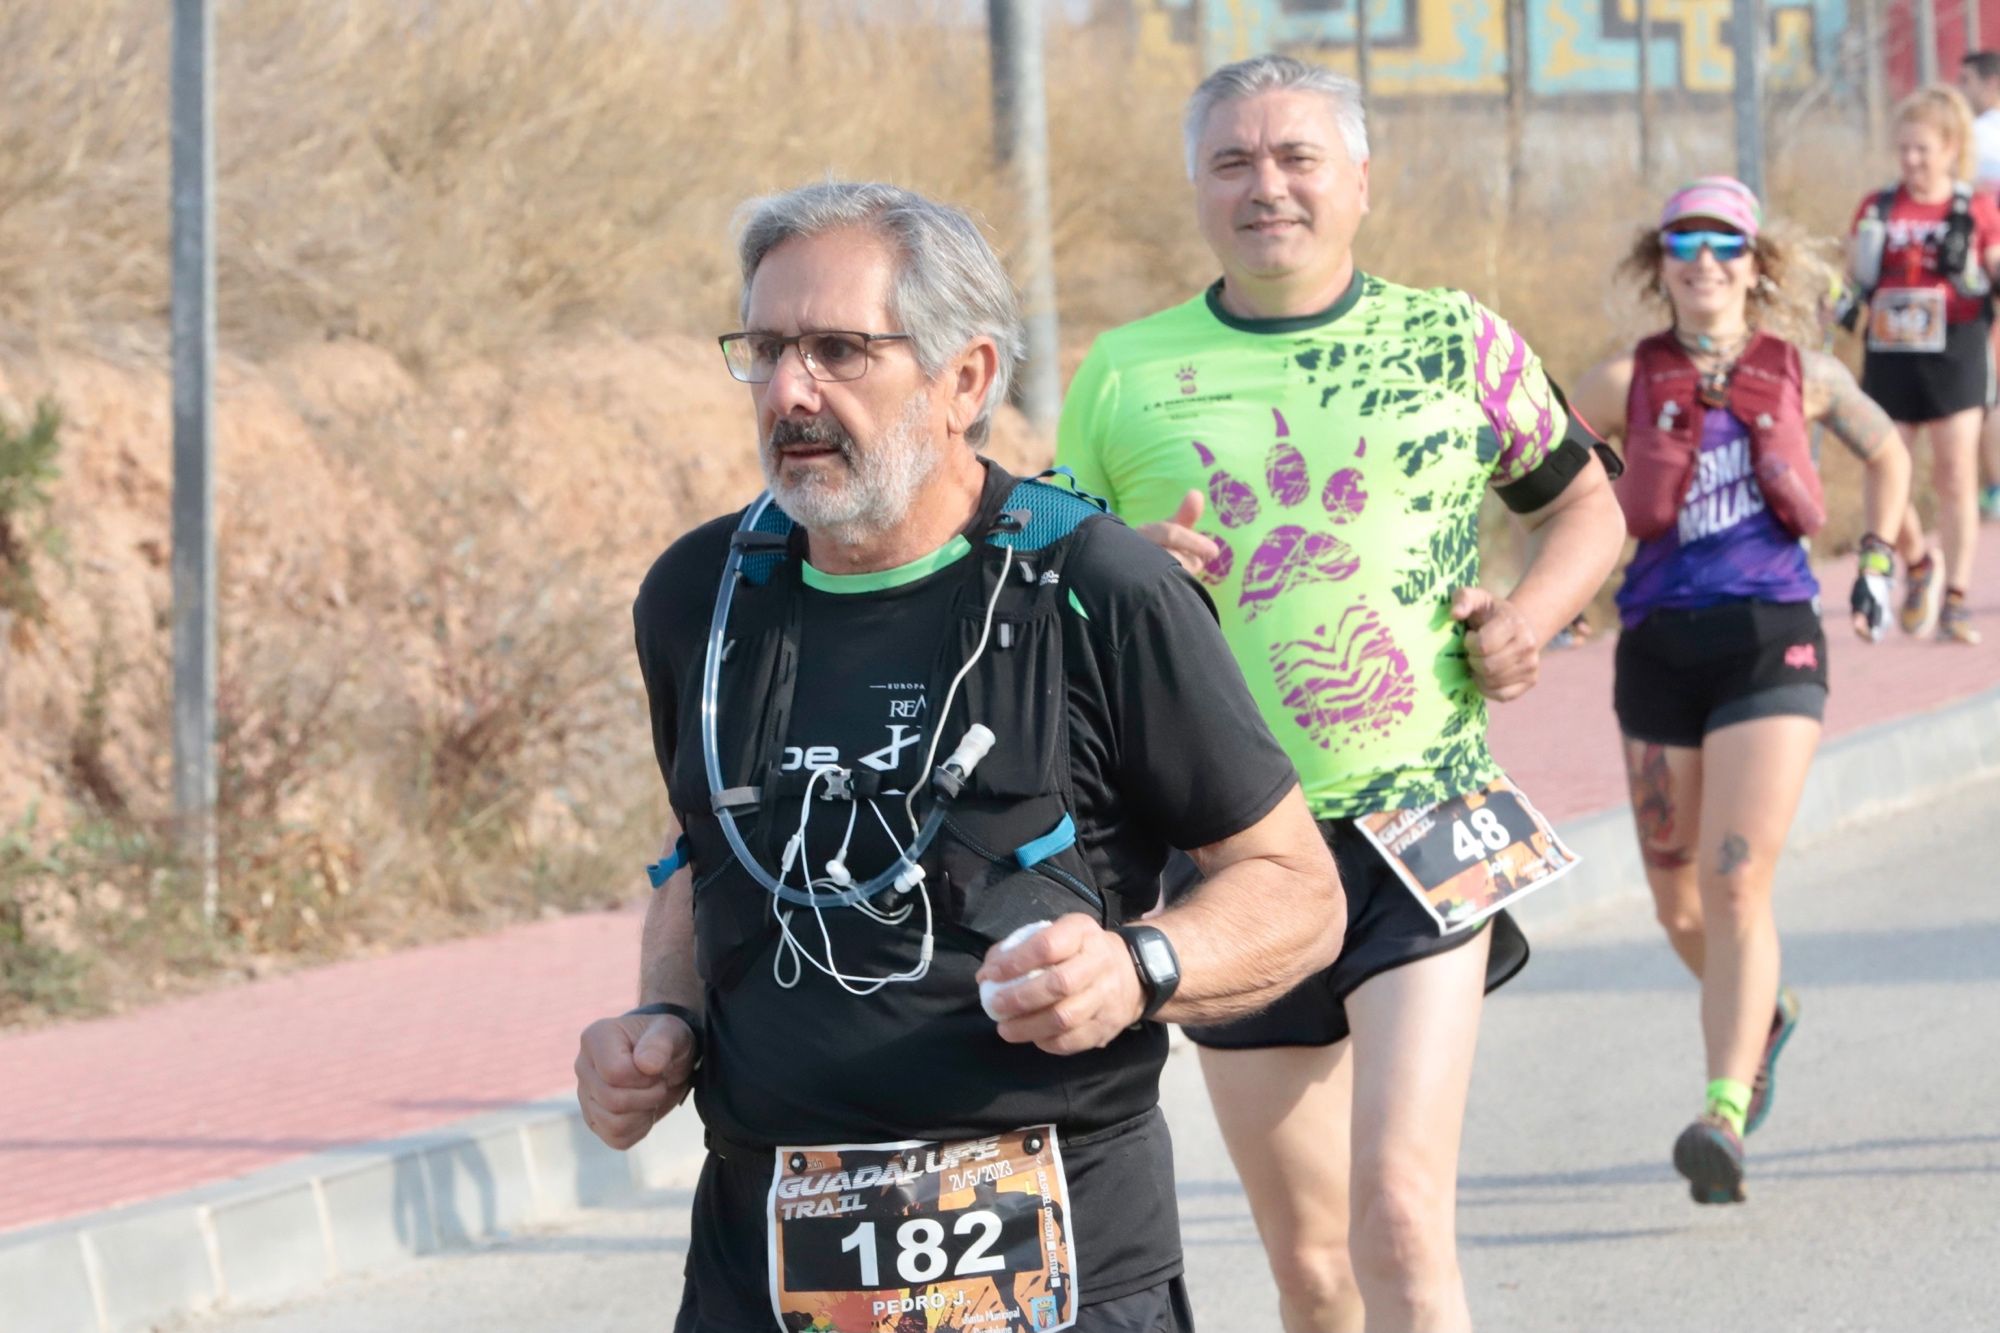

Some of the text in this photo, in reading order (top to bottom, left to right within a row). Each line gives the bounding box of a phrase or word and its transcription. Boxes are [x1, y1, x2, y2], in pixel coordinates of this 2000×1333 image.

[1452, 807, 1511, 863] 48
[777, 1134, 1001, 1199] GUADALUPE
[782, 1193, 868, 1220] TRAIL
[841, 1210, 1006, 1287] 182
[873, 1290, 972, 1316] PEDRO J.
